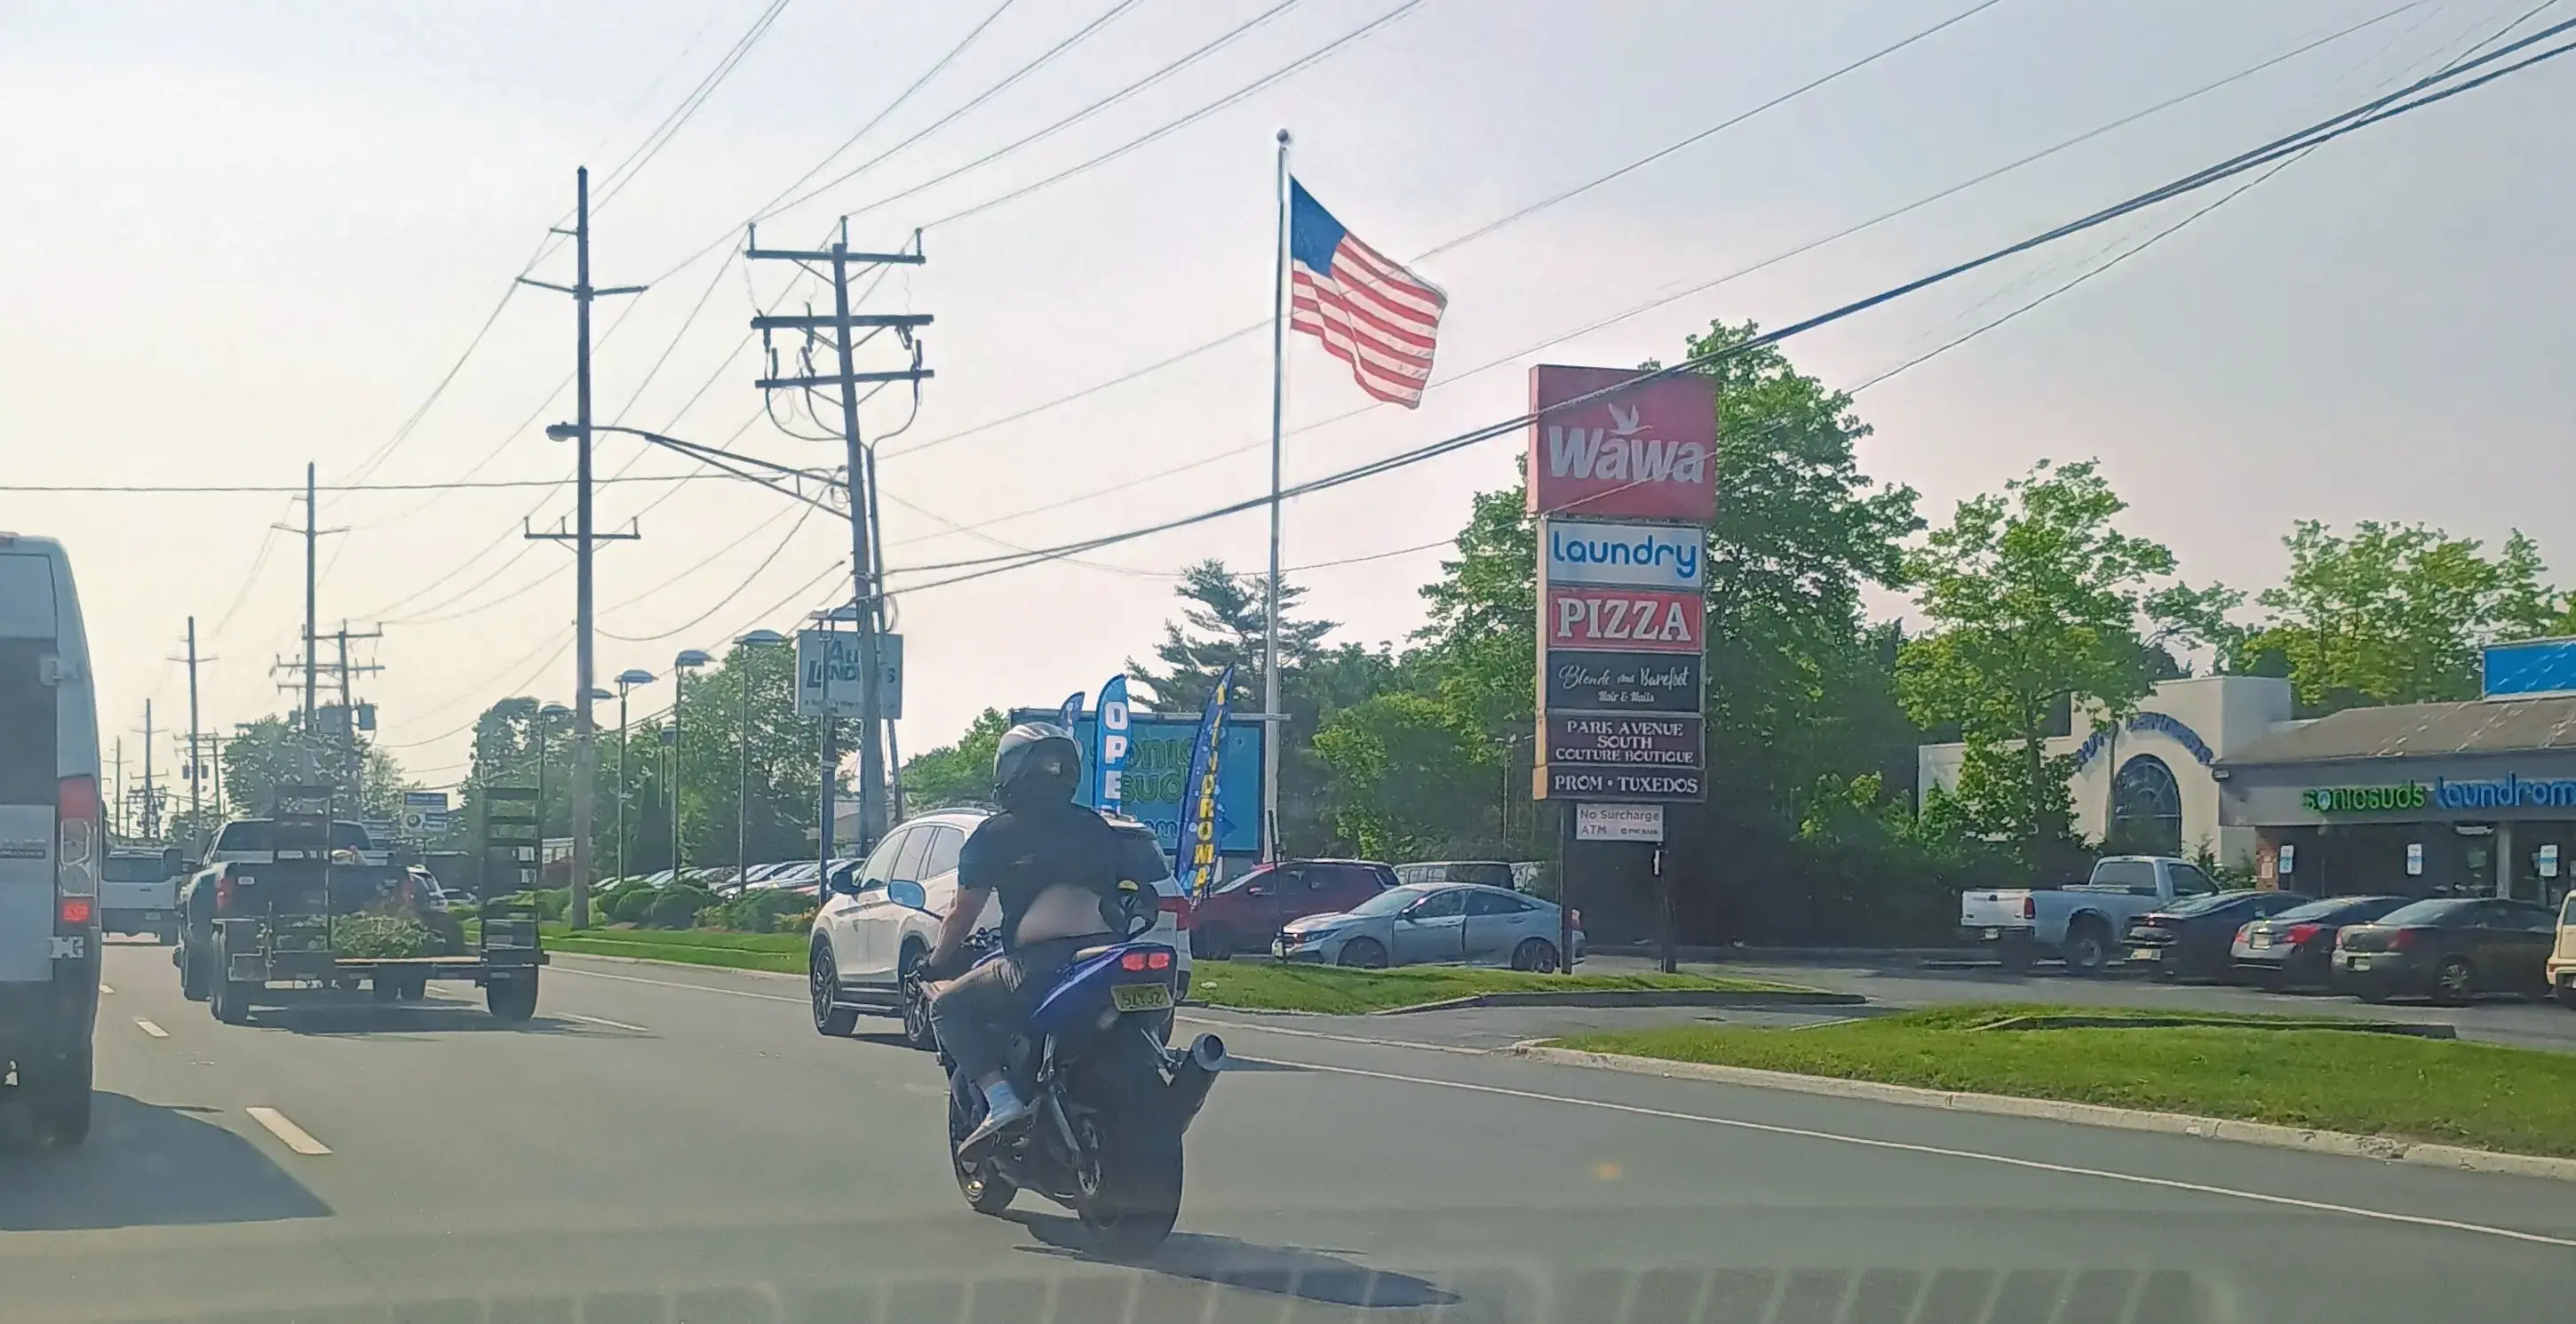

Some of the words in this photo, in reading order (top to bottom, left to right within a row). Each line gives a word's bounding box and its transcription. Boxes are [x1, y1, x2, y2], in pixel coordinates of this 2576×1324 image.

[1548, 426, 1705, 483] Wawa
[1554, 530, 1697, 578] laundry
[1556, 597, 1691, 642] PIZZA
[1640, 666, 1690, 691] Barefoot
[1598, 690, 1618, 702] Hair
[1620, 692, 1628, 702] &
[1630, 691, 1655, 703] Nails
[1567, 720, 1613, 735] PARK
[1618, 722, 1684, 737] AVENUE
[1597, 735, 1653, 750] SOUTH
[1555, 747, 1621, 762] COUTURE
[1625, 750, 1694, 763] BOUTIQUE
[1554, 775, 1602, 791] PROM
[1617, 776, 1699, 794] TUXEDOS
[1580, 810, 1597, 819] No
[1600, 810, 1660, 822] Surcharge
[1581, 825, 1607, 835] ATM
